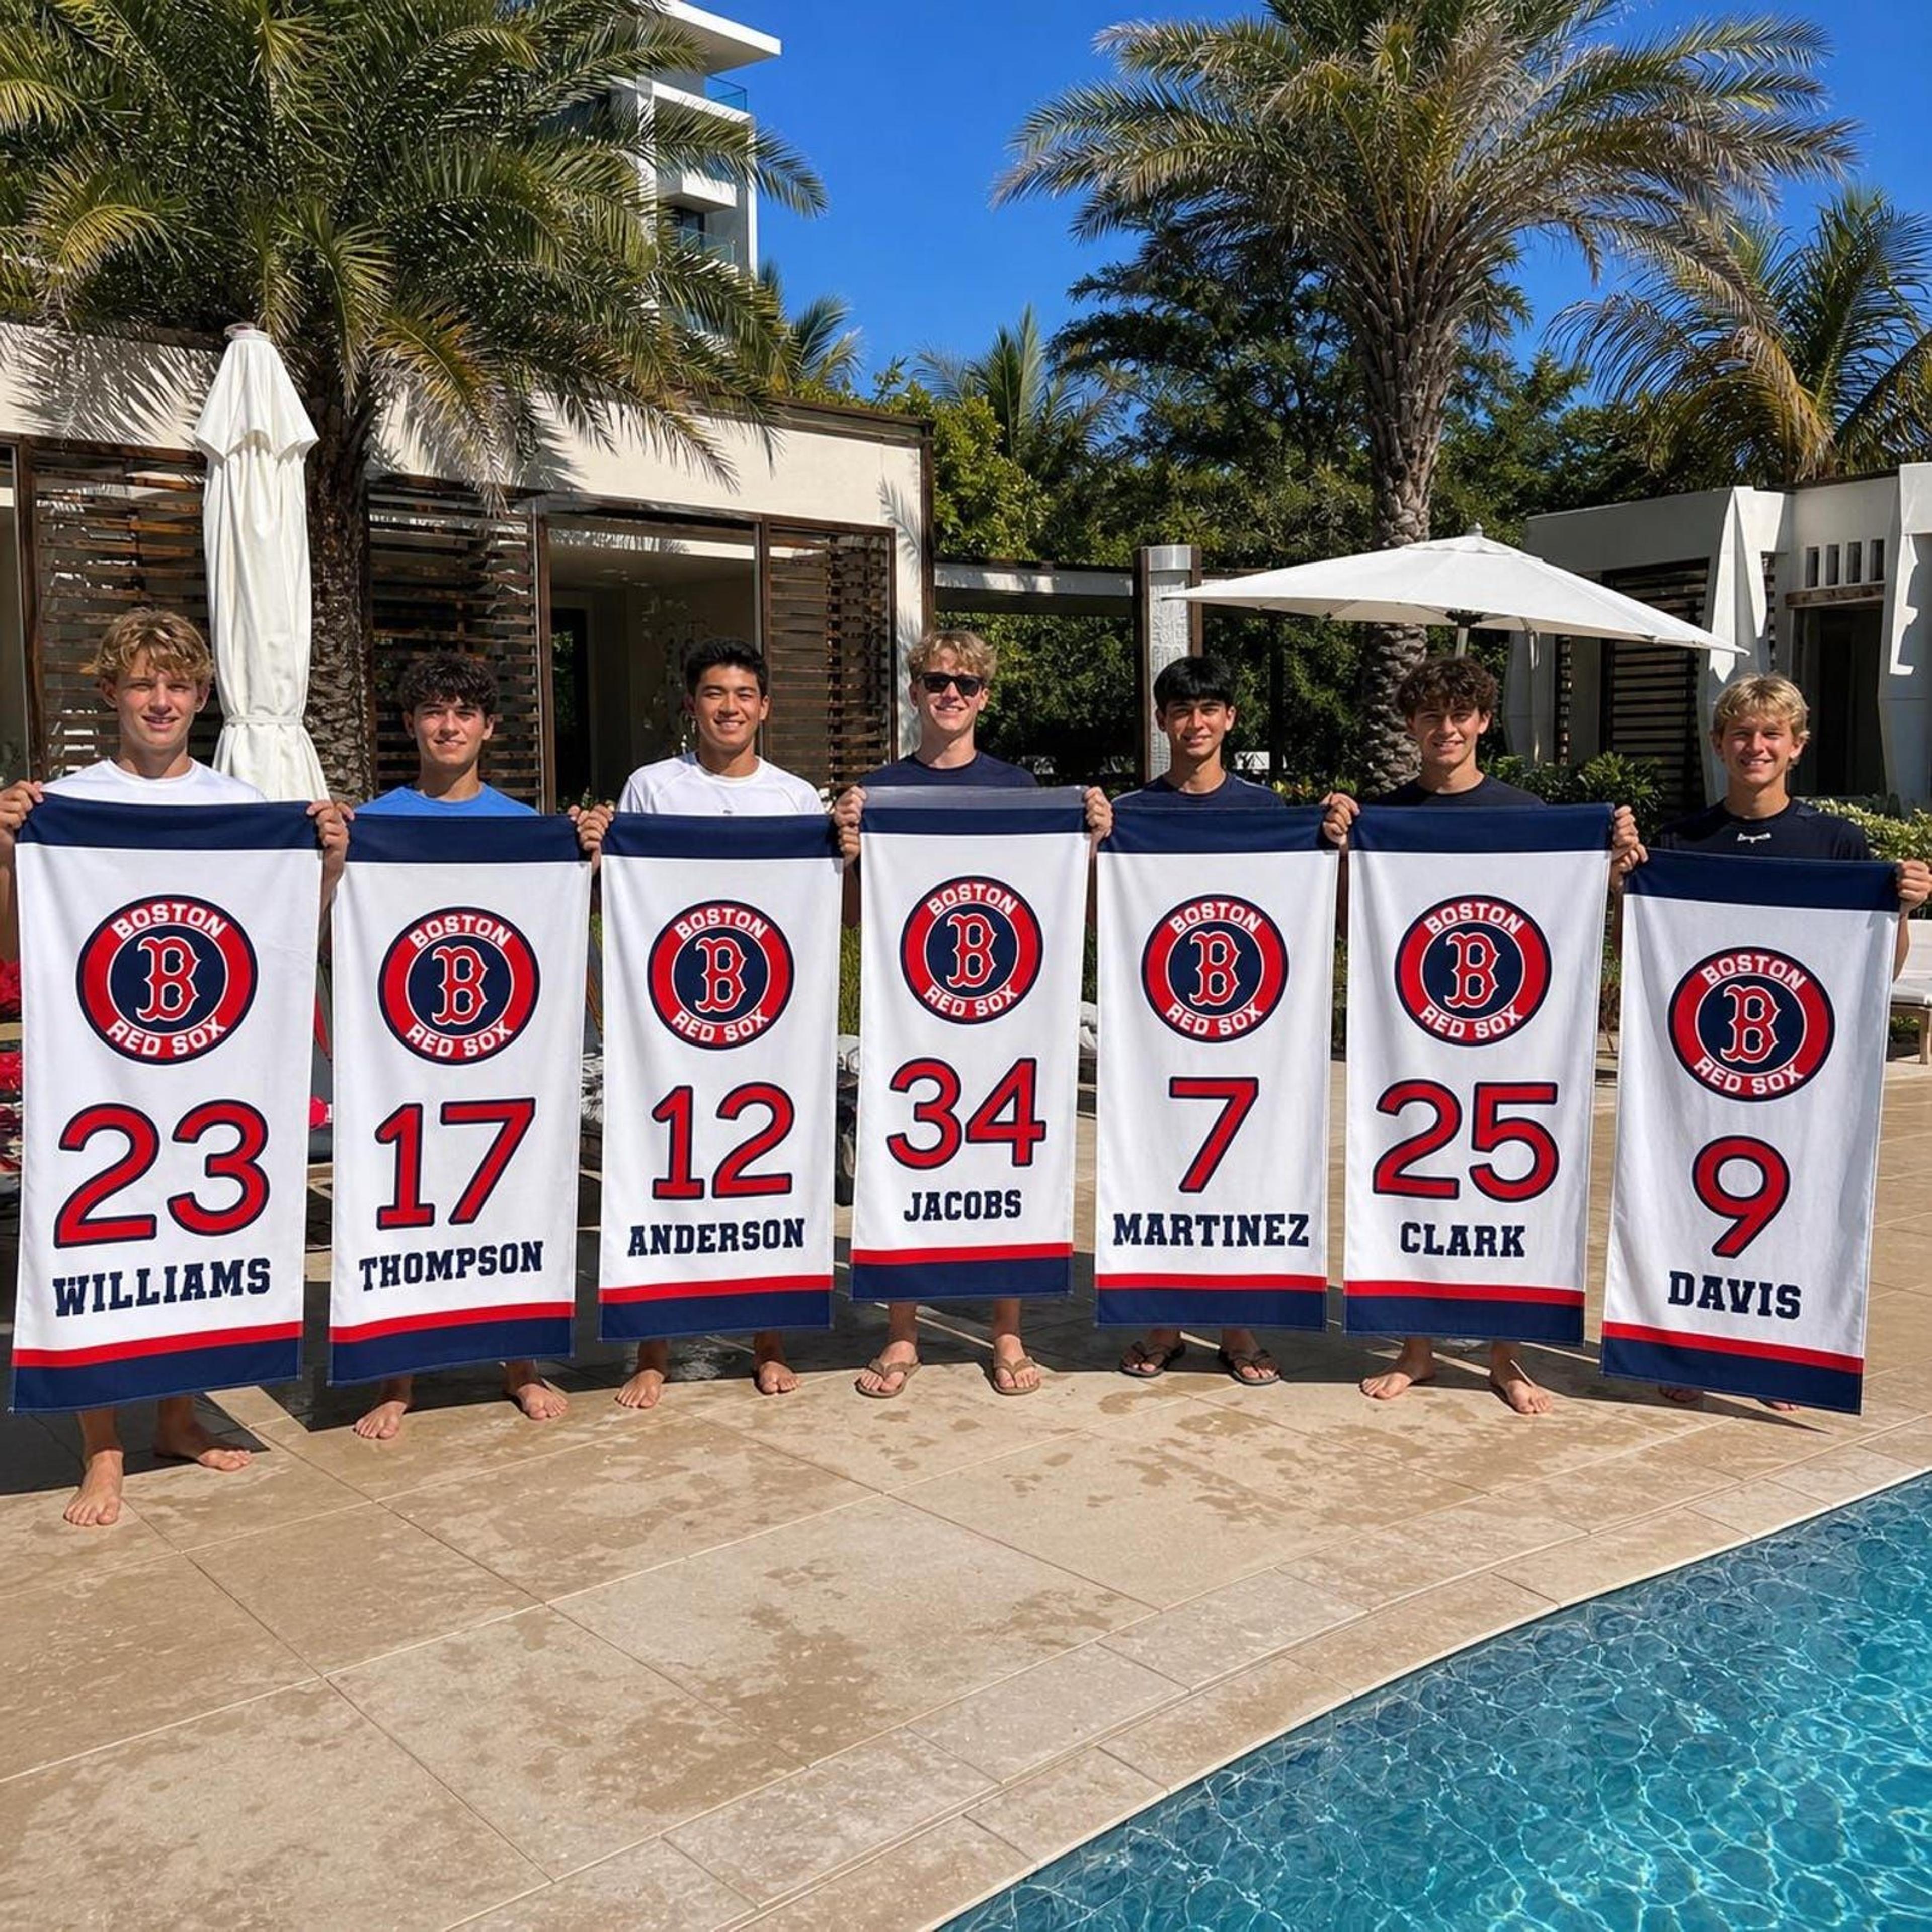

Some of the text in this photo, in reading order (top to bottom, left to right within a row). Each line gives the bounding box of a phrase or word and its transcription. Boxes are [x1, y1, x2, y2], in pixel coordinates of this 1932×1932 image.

[926, 883, 1018, 916] BOSTON
[1168, 901, 1263, 934] BOSTON
[1423, 902, 1525, 935] BOSTON
[111, 903, 228, 940] BOSTON
[408, 914, 513, 950] BOSTON
[674, 907, 769, 941] BOSTON
[945, 913, 998, 989] B
[1188, 930, 1242, 1006] B
[1443, 931, 1501, 1009] B
[135, 935, 202, 1023] B
[431, 945, 489, 1026] B
[694, 936, 748, 1013] B
[1700, 954, 1807, 991] BOSTON
[923, 984, 1018, 1017] RED SOX
[1165, 1002, 1264, 1036] RED SOX
[106, 1016, 227, 1056] RED SOX
[405, 1020, 513, 1057] RED SOX
[671, 1008, 770, 1042] RED SOX
[1418, 1004, 1523, 1039] RED SOX
[1720, 983, 1782, 1064] B
[1693, 1056, 1804, 1095] RED SOX
[886, 1057, 1047, 1171] 34
[651, 1081, 795, 1201] 12
[1168, 1076, 1259, 1194] 7
[1372, 1078, 1560, 1203] 25
[53, 1099, 271, 1250] 23
[374, 1097, 536, 1231] 17
[903, 1189, 1022, 1222] JACOBS
[1691, 1135, 1791, 1260] 9
[627, 1218, 806, 1257] ANDERSON
[1113, 1213, 1309, 1248] MARTINEZ
[1400, 1221, 1525, 1258] CLARK
[359, 1240, 544, 1292] THOMPSON
[52, 1257, 271, 1317] WILLIAMS
[1667, 1270, 1802, 1320] DAVIS
